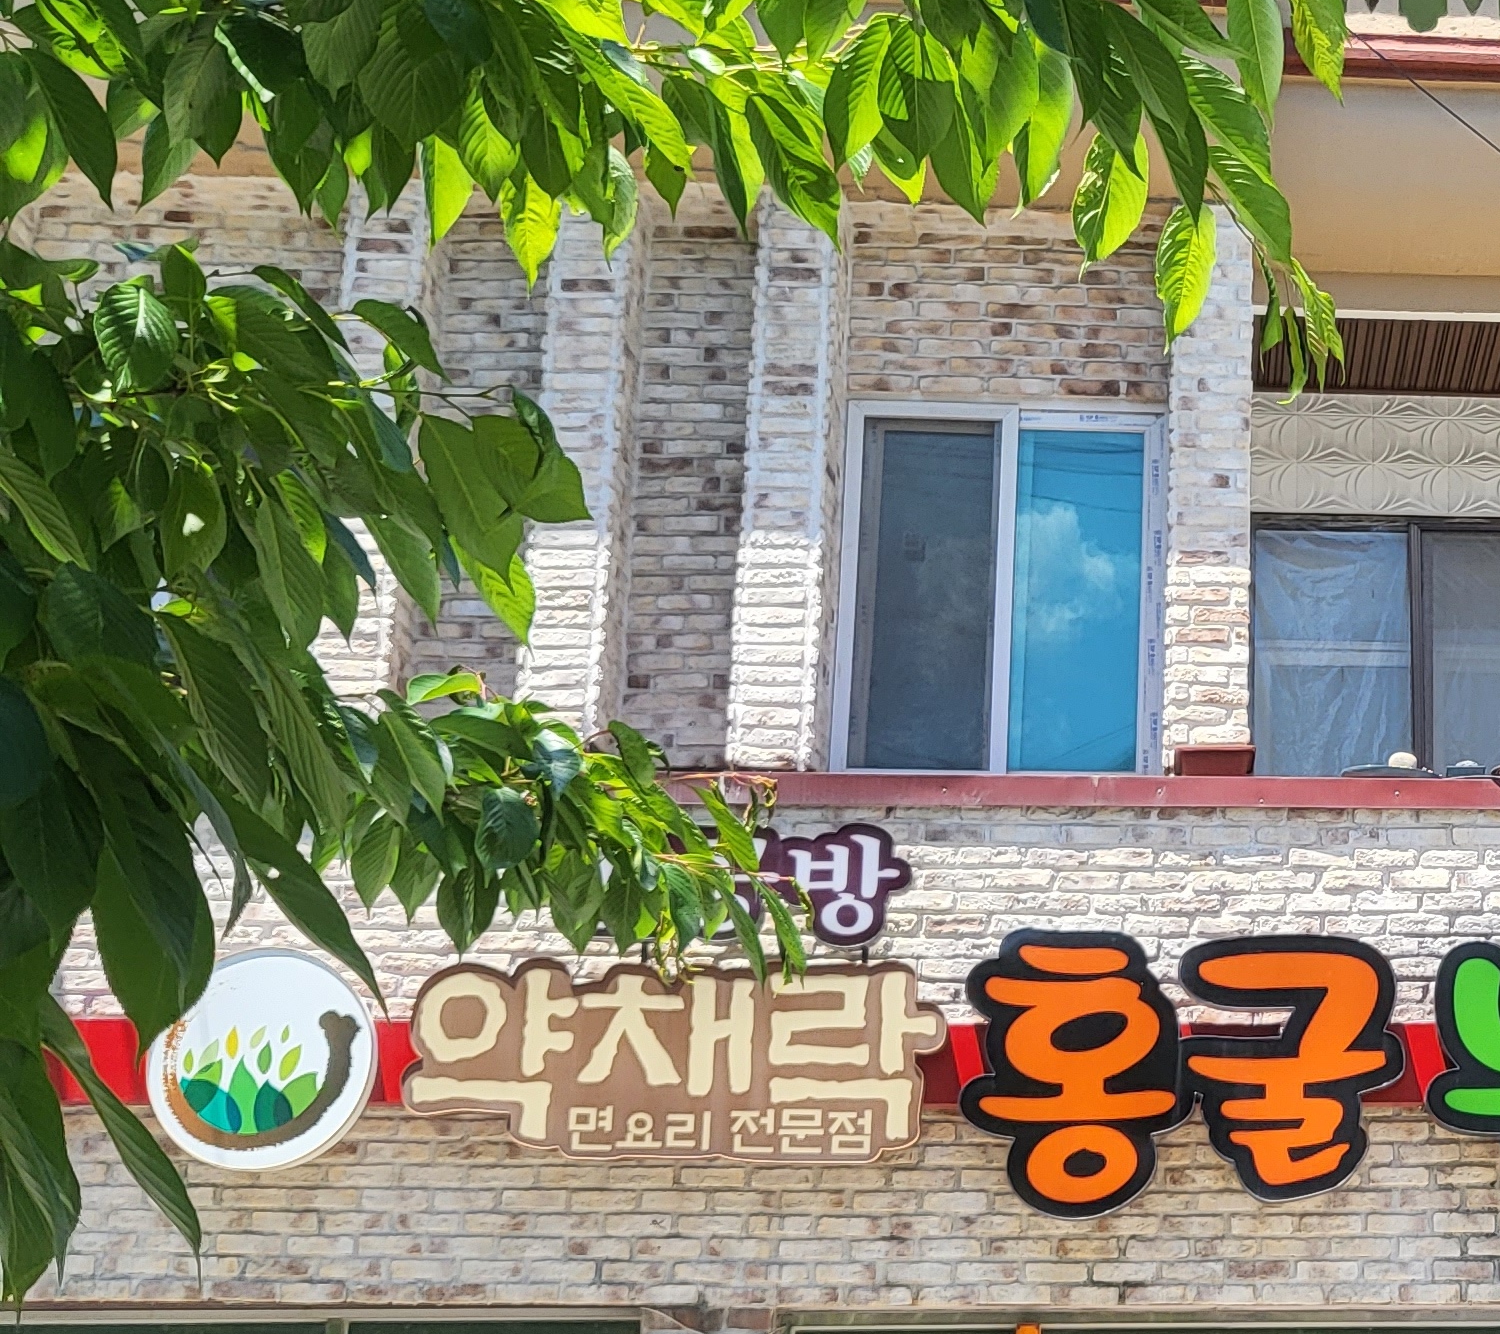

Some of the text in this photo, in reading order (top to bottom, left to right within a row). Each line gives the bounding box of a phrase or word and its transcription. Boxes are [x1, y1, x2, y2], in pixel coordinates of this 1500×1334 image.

[410, 968, 938, 1142] 약채락
[568, 1105, 874, 1155] 면요리 전문점
